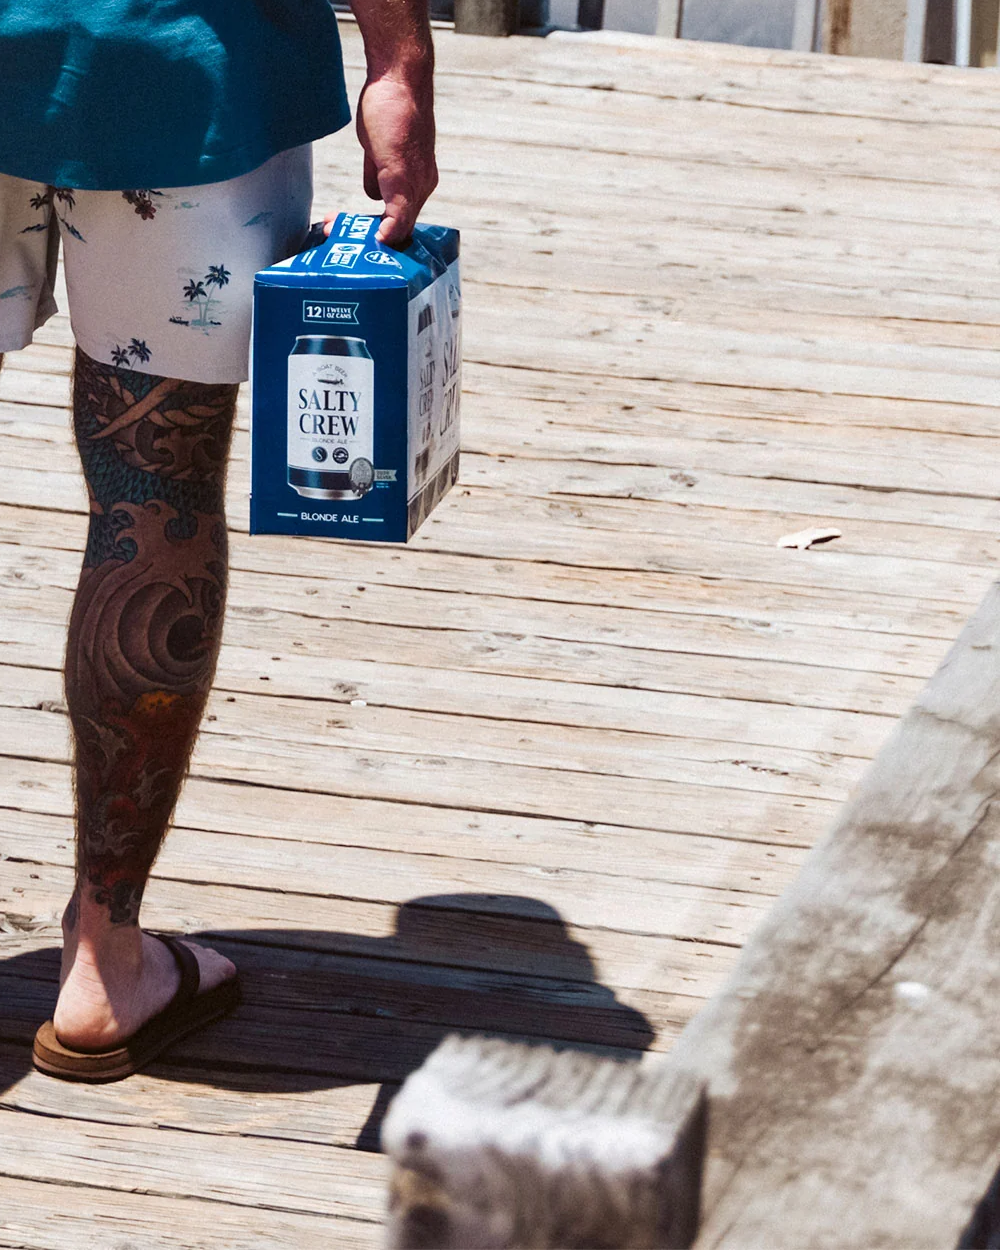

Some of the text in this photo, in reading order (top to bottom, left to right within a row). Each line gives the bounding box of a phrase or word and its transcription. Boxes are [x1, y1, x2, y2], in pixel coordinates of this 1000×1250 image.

[306, 306, 322, 318] 12
[298, 388, 361, 412] SALTY
[299, 413, 359, 436] CREW
[300, 511, 359, 524] BLONDE ALE
